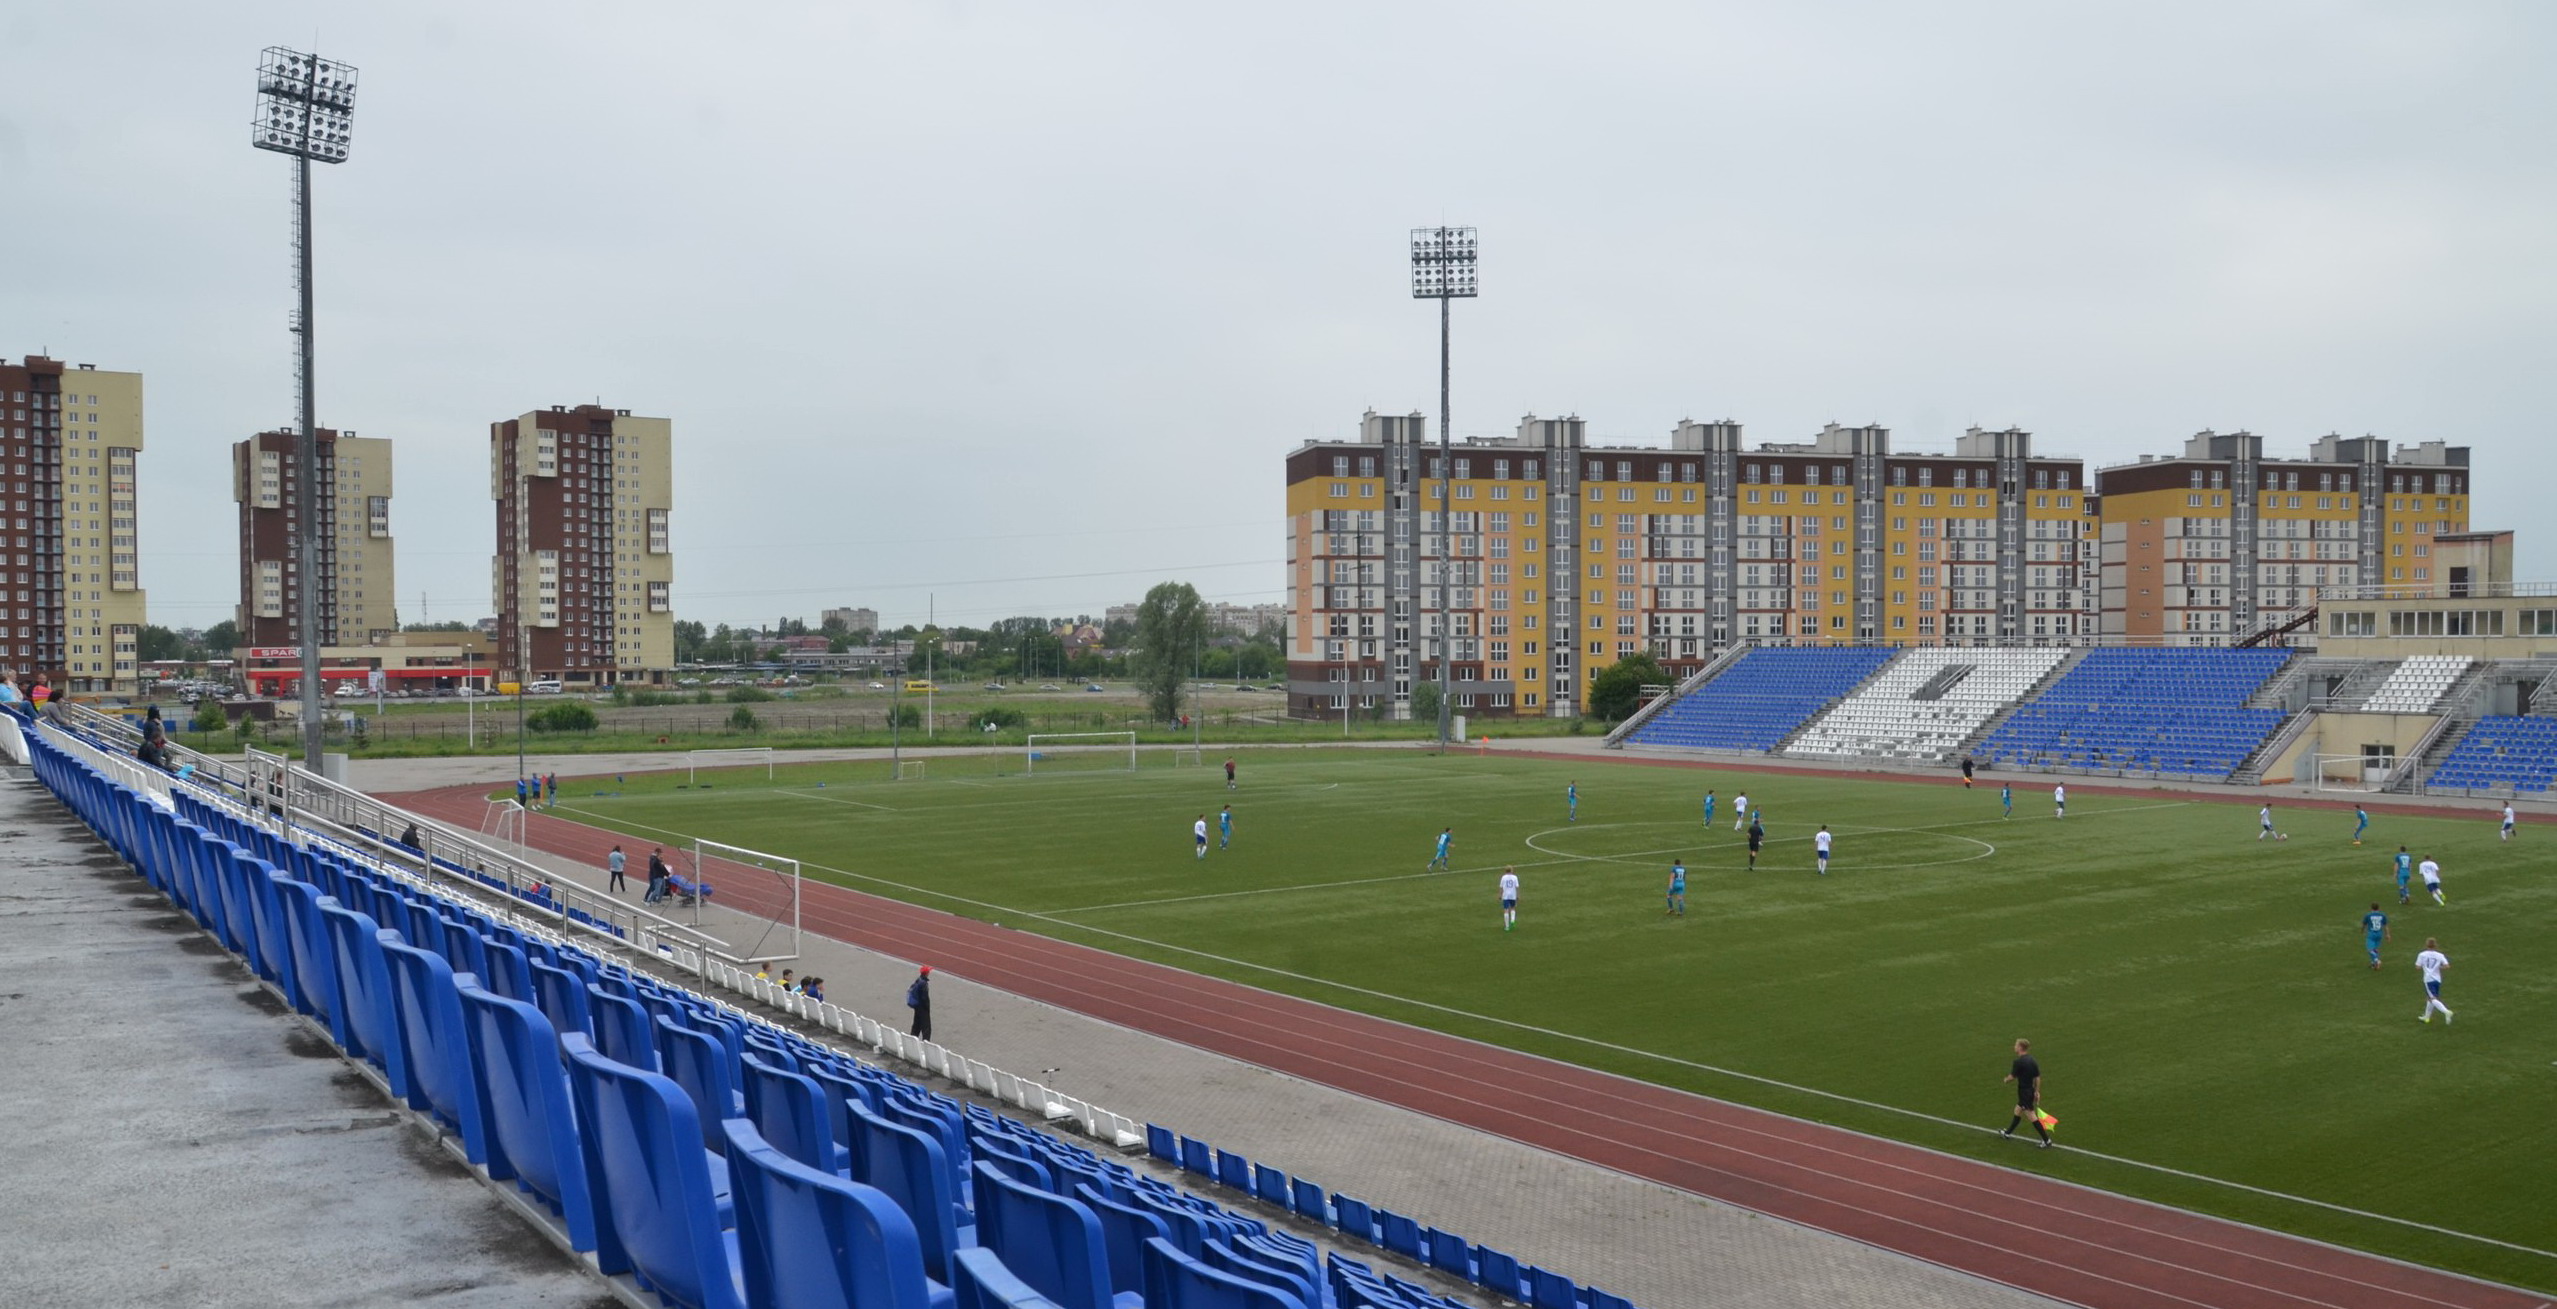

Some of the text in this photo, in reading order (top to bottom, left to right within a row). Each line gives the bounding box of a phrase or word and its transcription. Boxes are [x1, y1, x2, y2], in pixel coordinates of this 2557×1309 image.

[261, 649, 296, 657] SPAR
[1506, 879, 1514, 888] 19
[2426, 957, 2438, 969] 17
